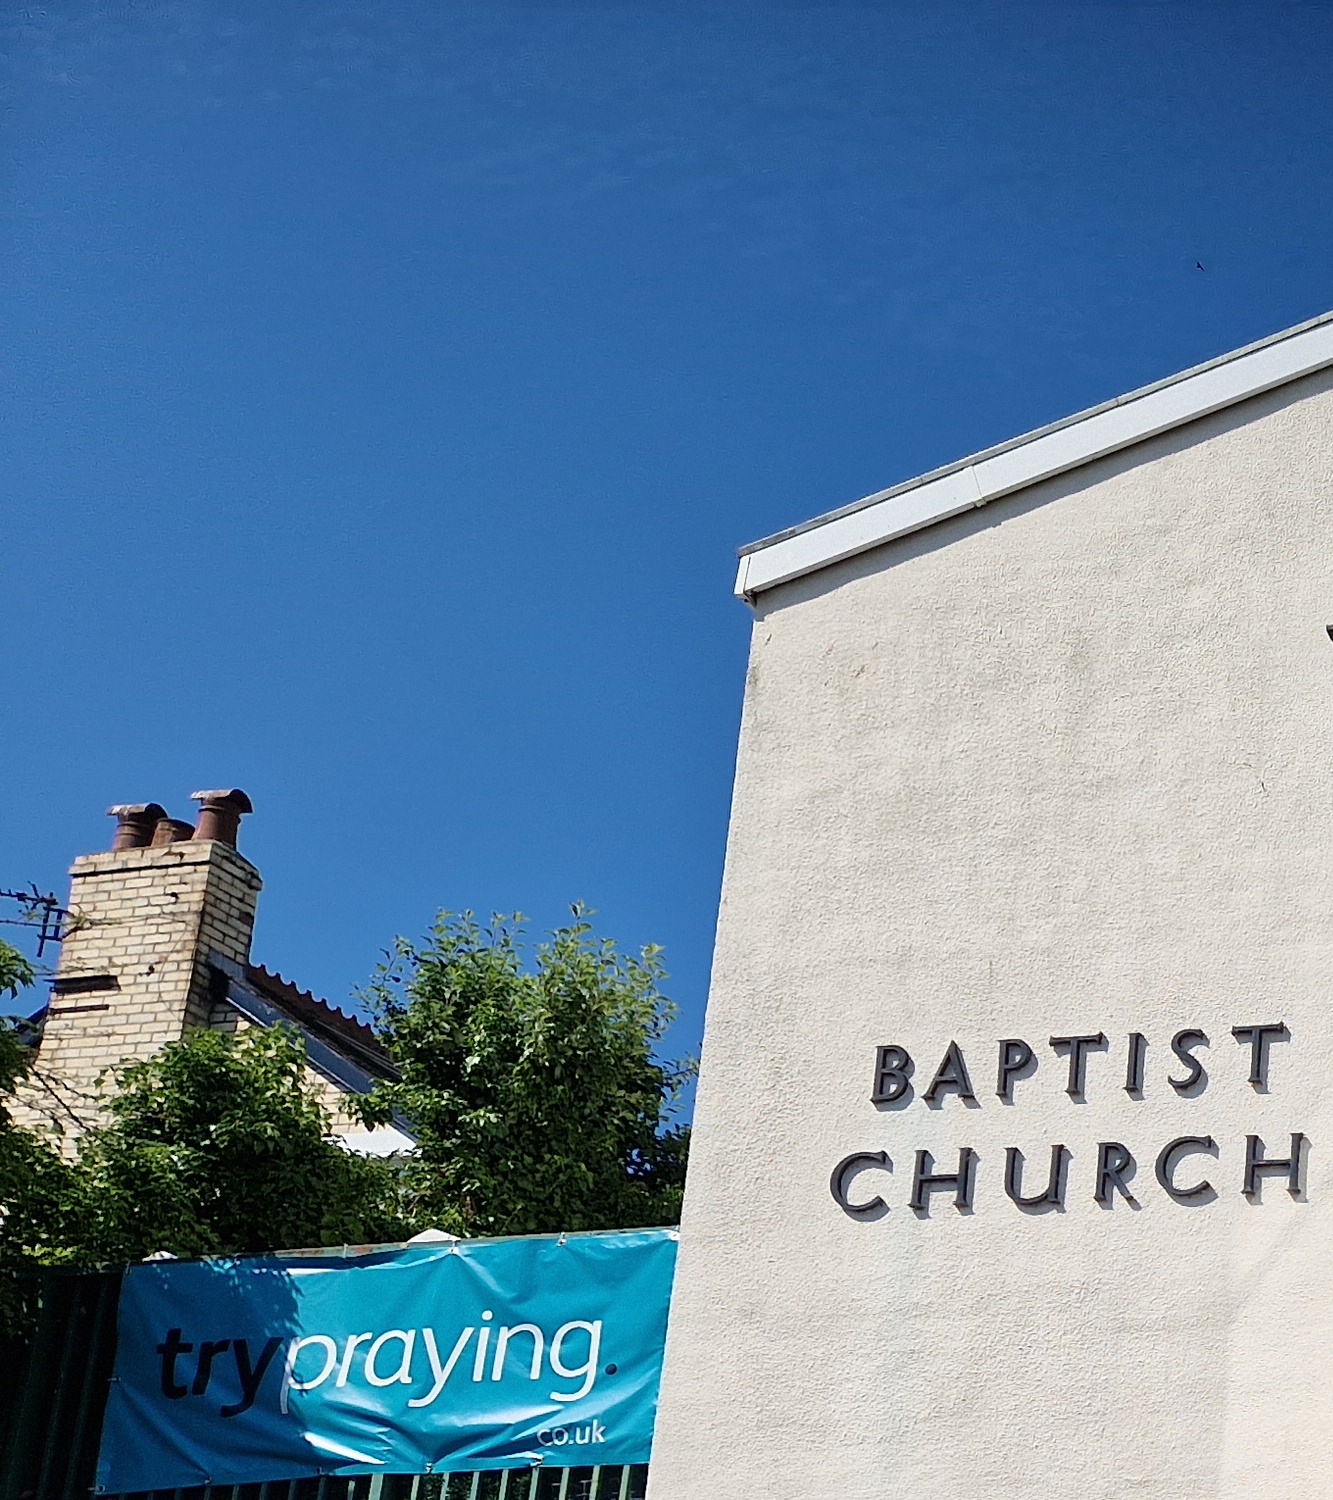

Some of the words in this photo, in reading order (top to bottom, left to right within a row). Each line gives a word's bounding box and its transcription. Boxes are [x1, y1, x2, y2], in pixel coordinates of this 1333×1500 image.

[870, 1021, 1287, 1105] BAPTIST
[830, 1132, 1308, 1214] CHURCH
[537, 1418, 606, 1447] co.uk
